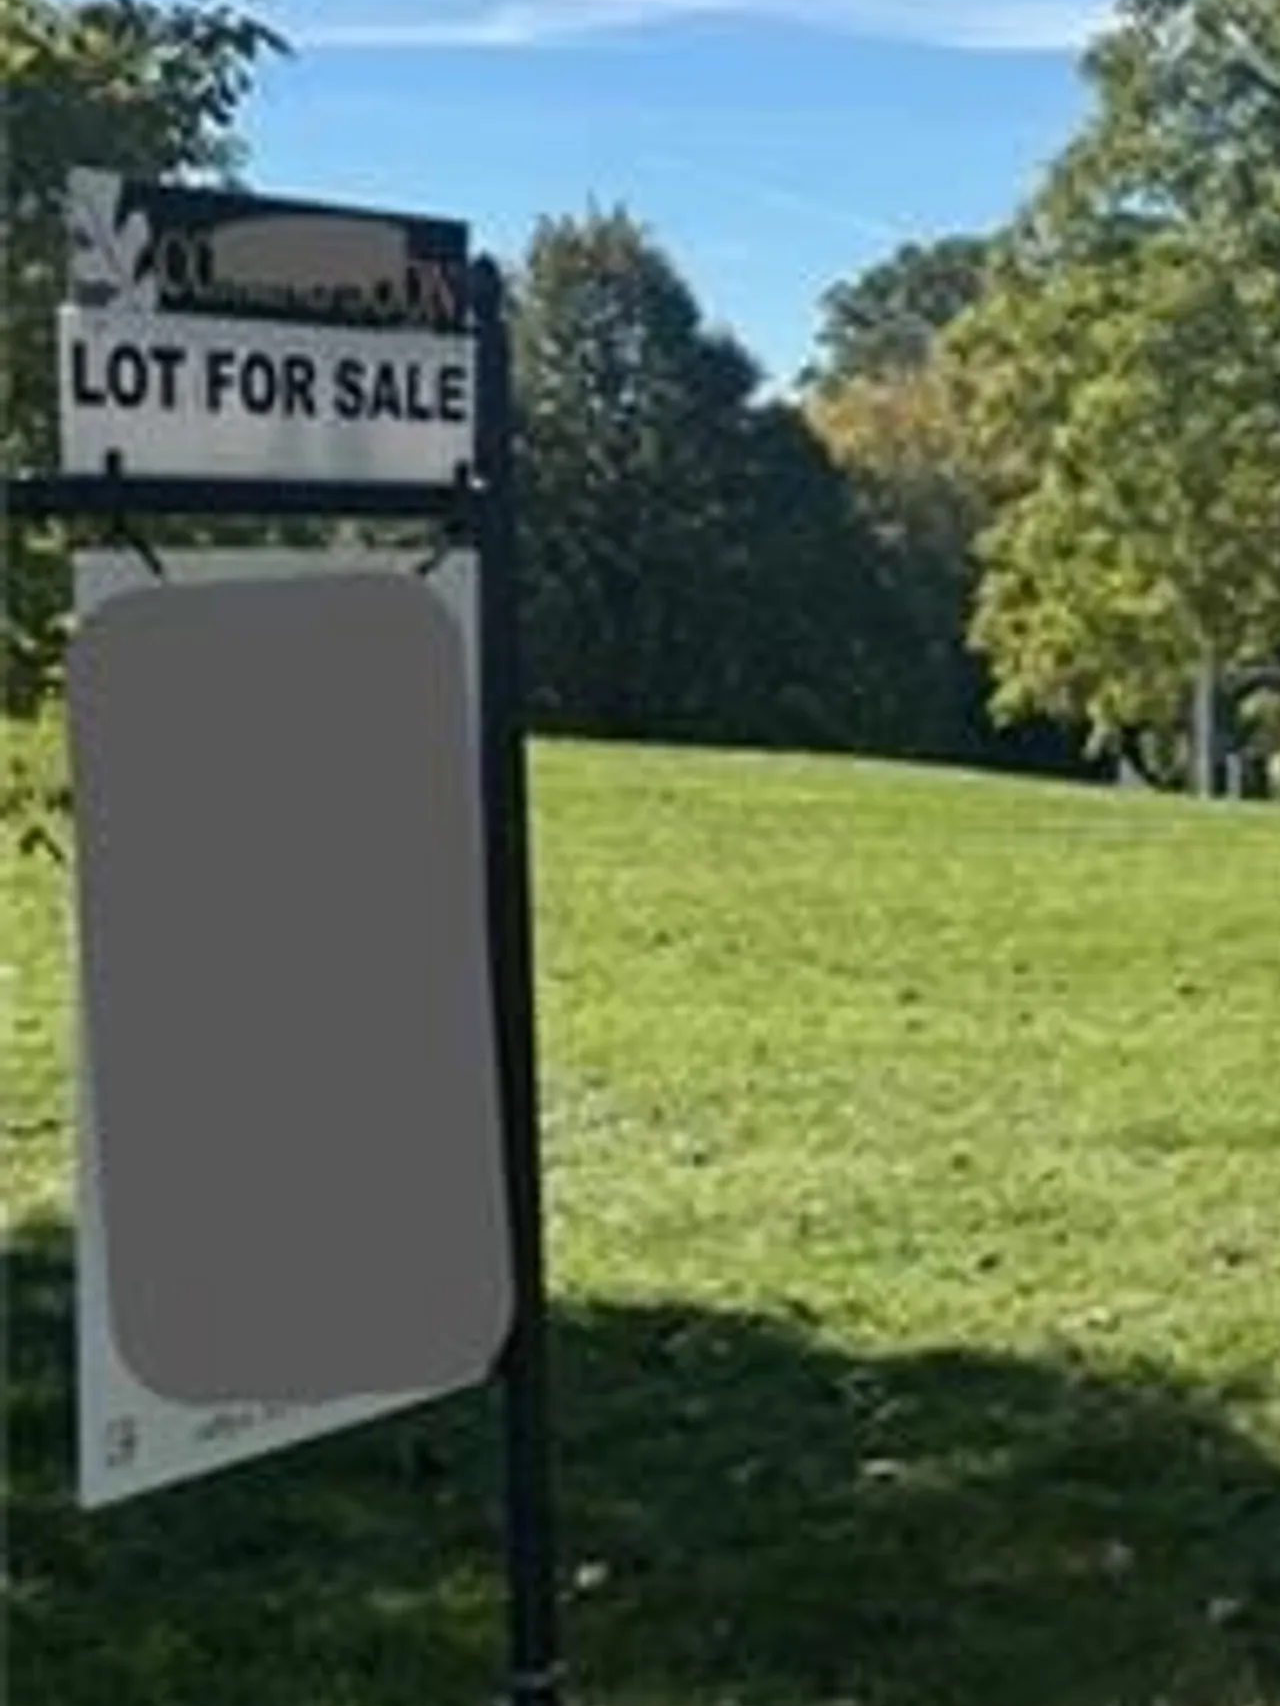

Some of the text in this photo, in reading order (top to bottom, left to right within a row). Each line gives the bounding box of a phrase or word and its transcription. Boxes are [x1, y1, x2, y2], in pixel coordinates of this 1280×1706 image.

[70, 341, 468, 424] LOT FOR SALE
